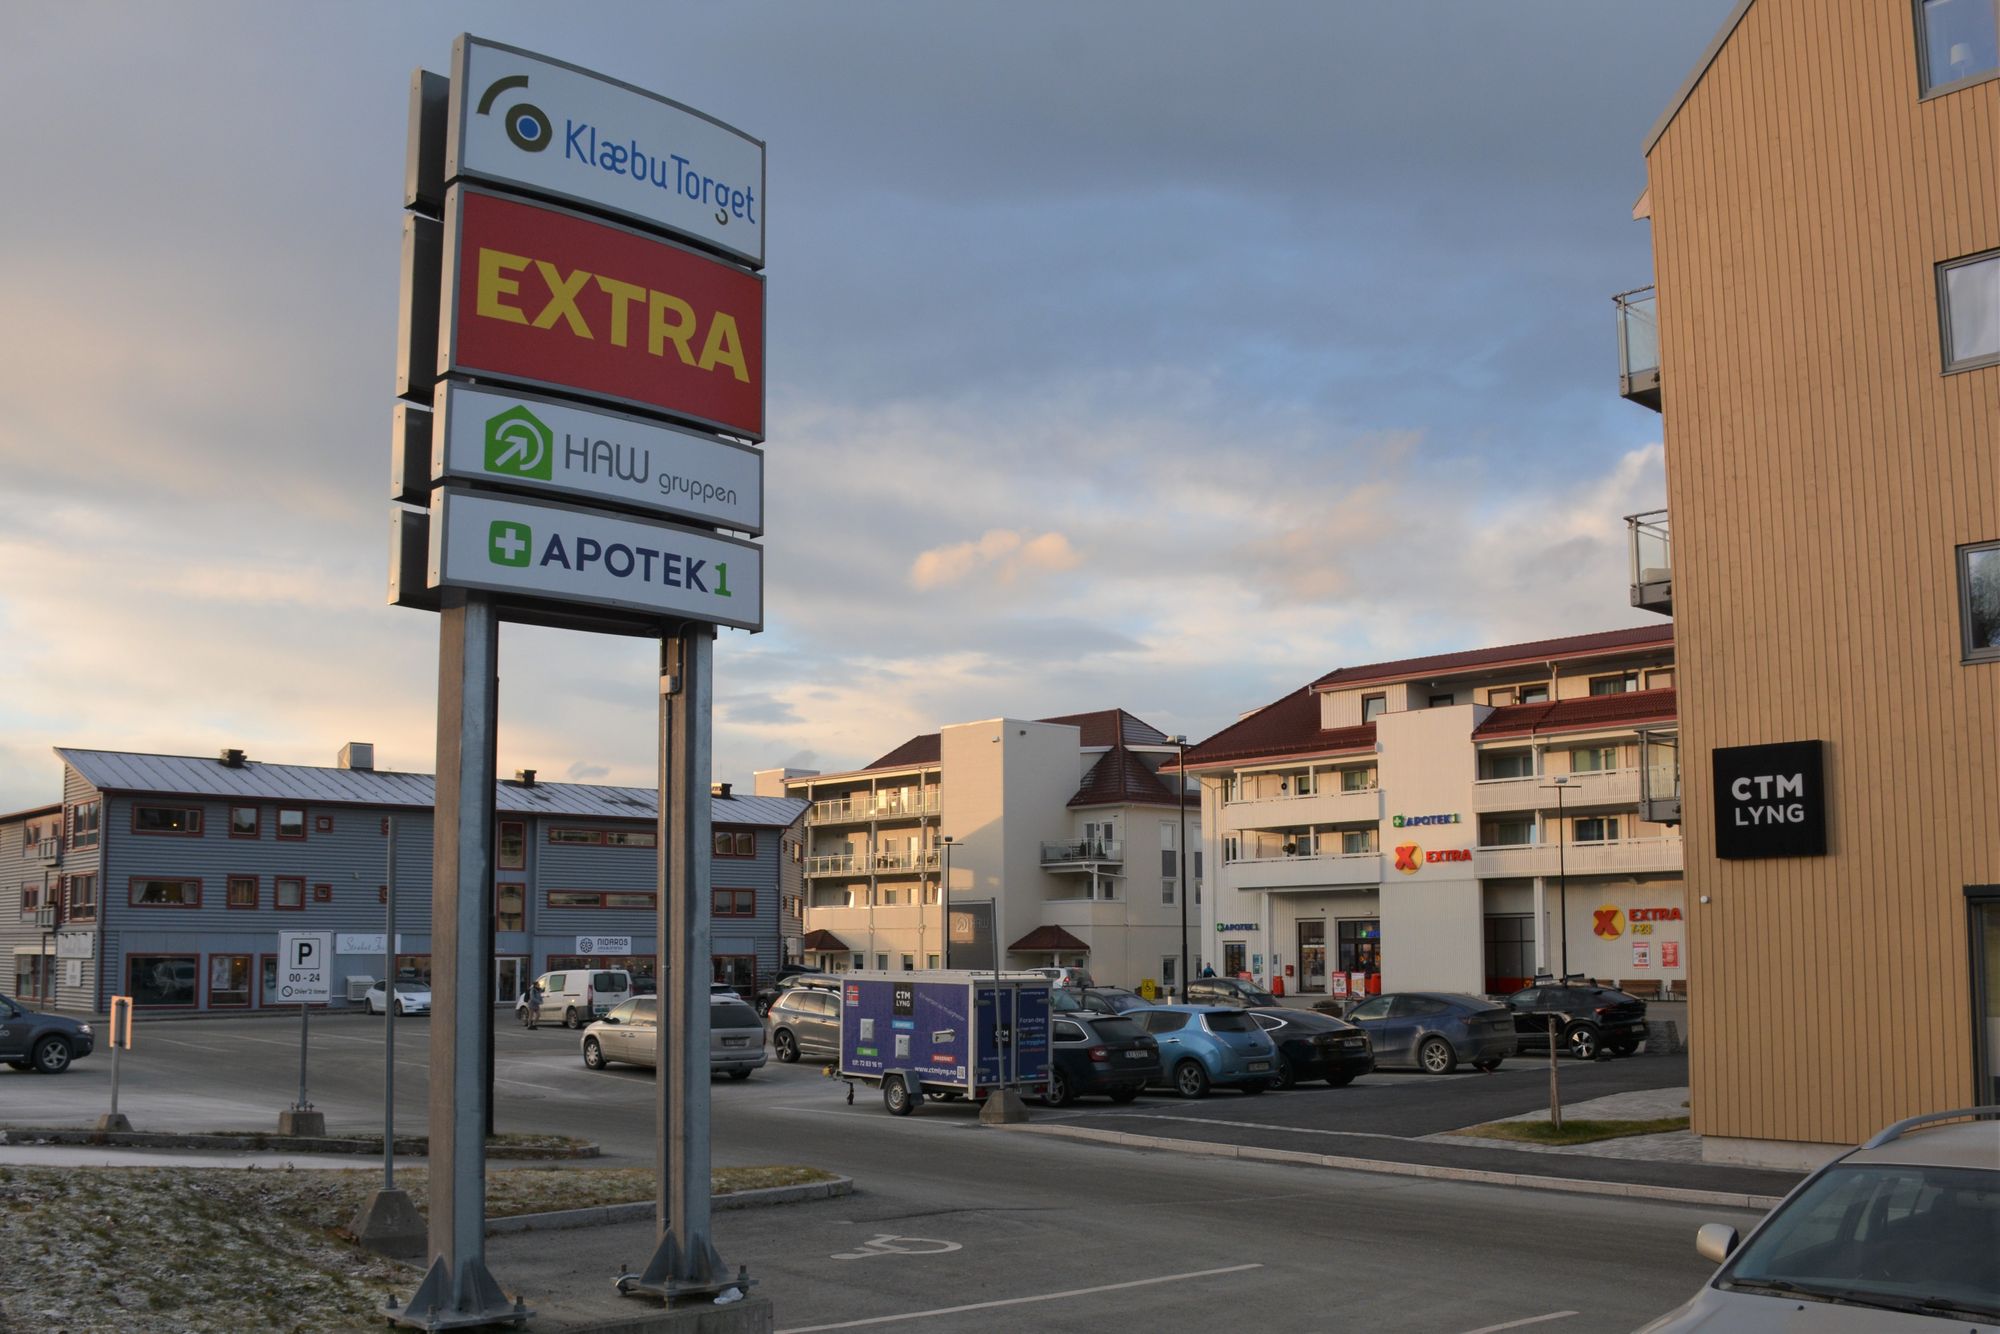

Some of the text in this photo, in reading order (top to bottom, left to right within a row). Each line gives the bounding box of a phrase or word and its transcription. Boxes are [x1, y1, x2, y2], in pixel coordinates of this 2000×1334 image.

[565, 119, 756, 225] KlæbuTorget
[476, 247, 751, 383] EXTRA
[565, 434, 737, 505] HAW gruppen
[1731, 773, 1804, 801] CTM
[1735, 803, 1805, 826] LYNG
[1425, 849, 1472, 863] EXTRA
[1628, 907, 1683, 922] EXTRA
[597, 938, 629, 946] NIDAROS
[298, 943, 313, 965] P
[289, 973, 301, 982] 00
[309, 973, 320, 982] 24
[896, 991, 911, 1000] CTM
